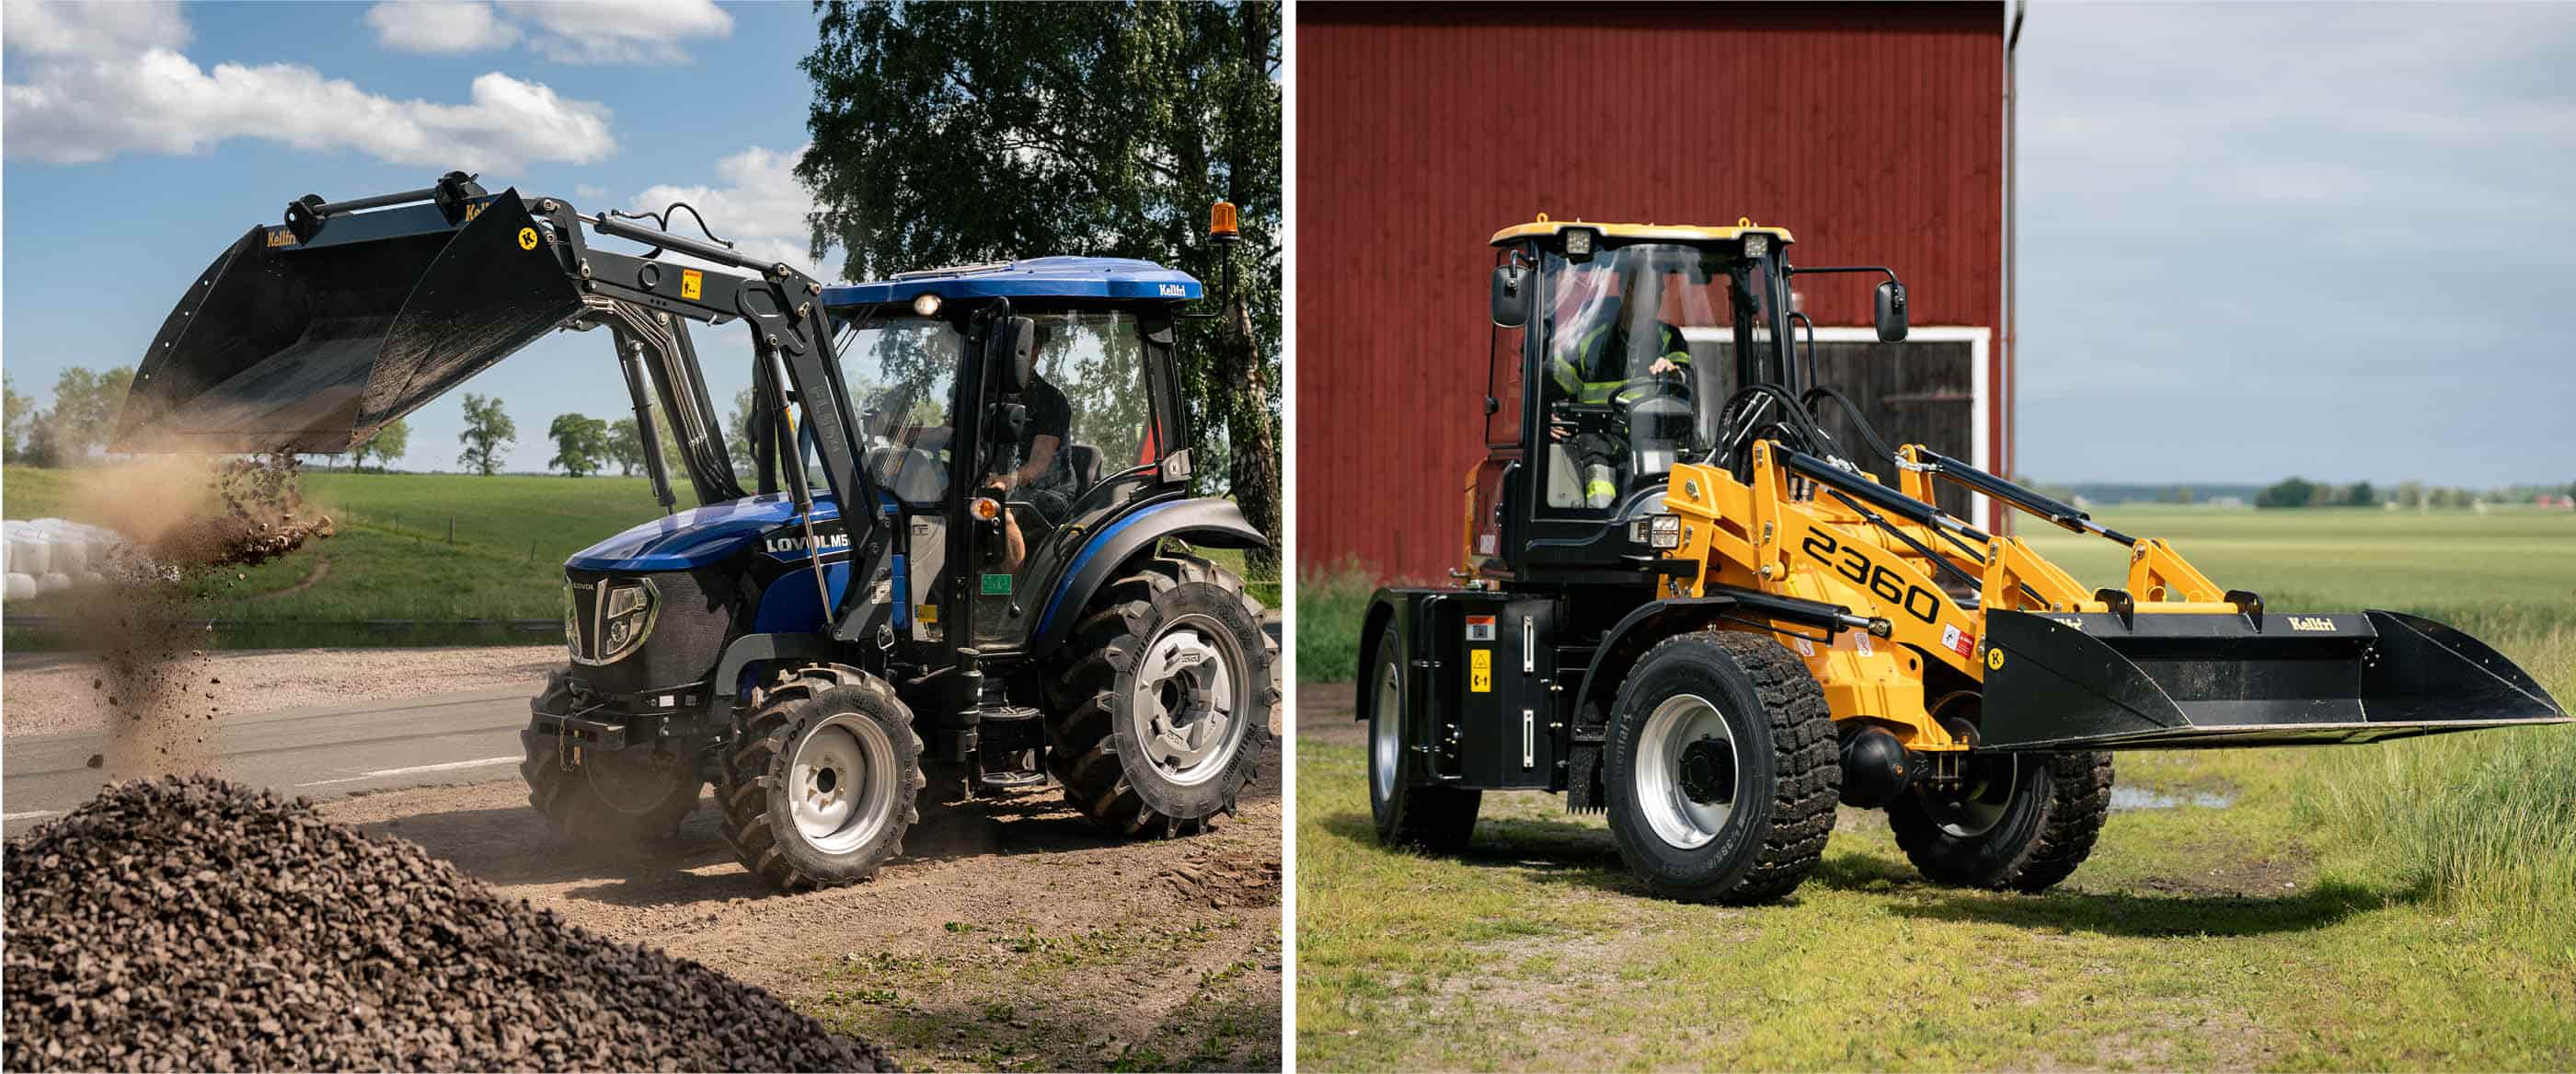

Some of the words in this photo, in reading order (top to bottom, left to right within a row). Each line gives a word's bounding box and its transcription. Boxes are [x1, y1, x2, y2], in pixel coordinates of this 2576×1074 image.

[1159, 283, 1186, 297] Kellfri
[765, 536, 830, 552] LOVOL
[831, 534, 851, 548] M5
[1801, 525, 1940, 624] 2360
[2288, 617, 2337, 631] Kellfri
